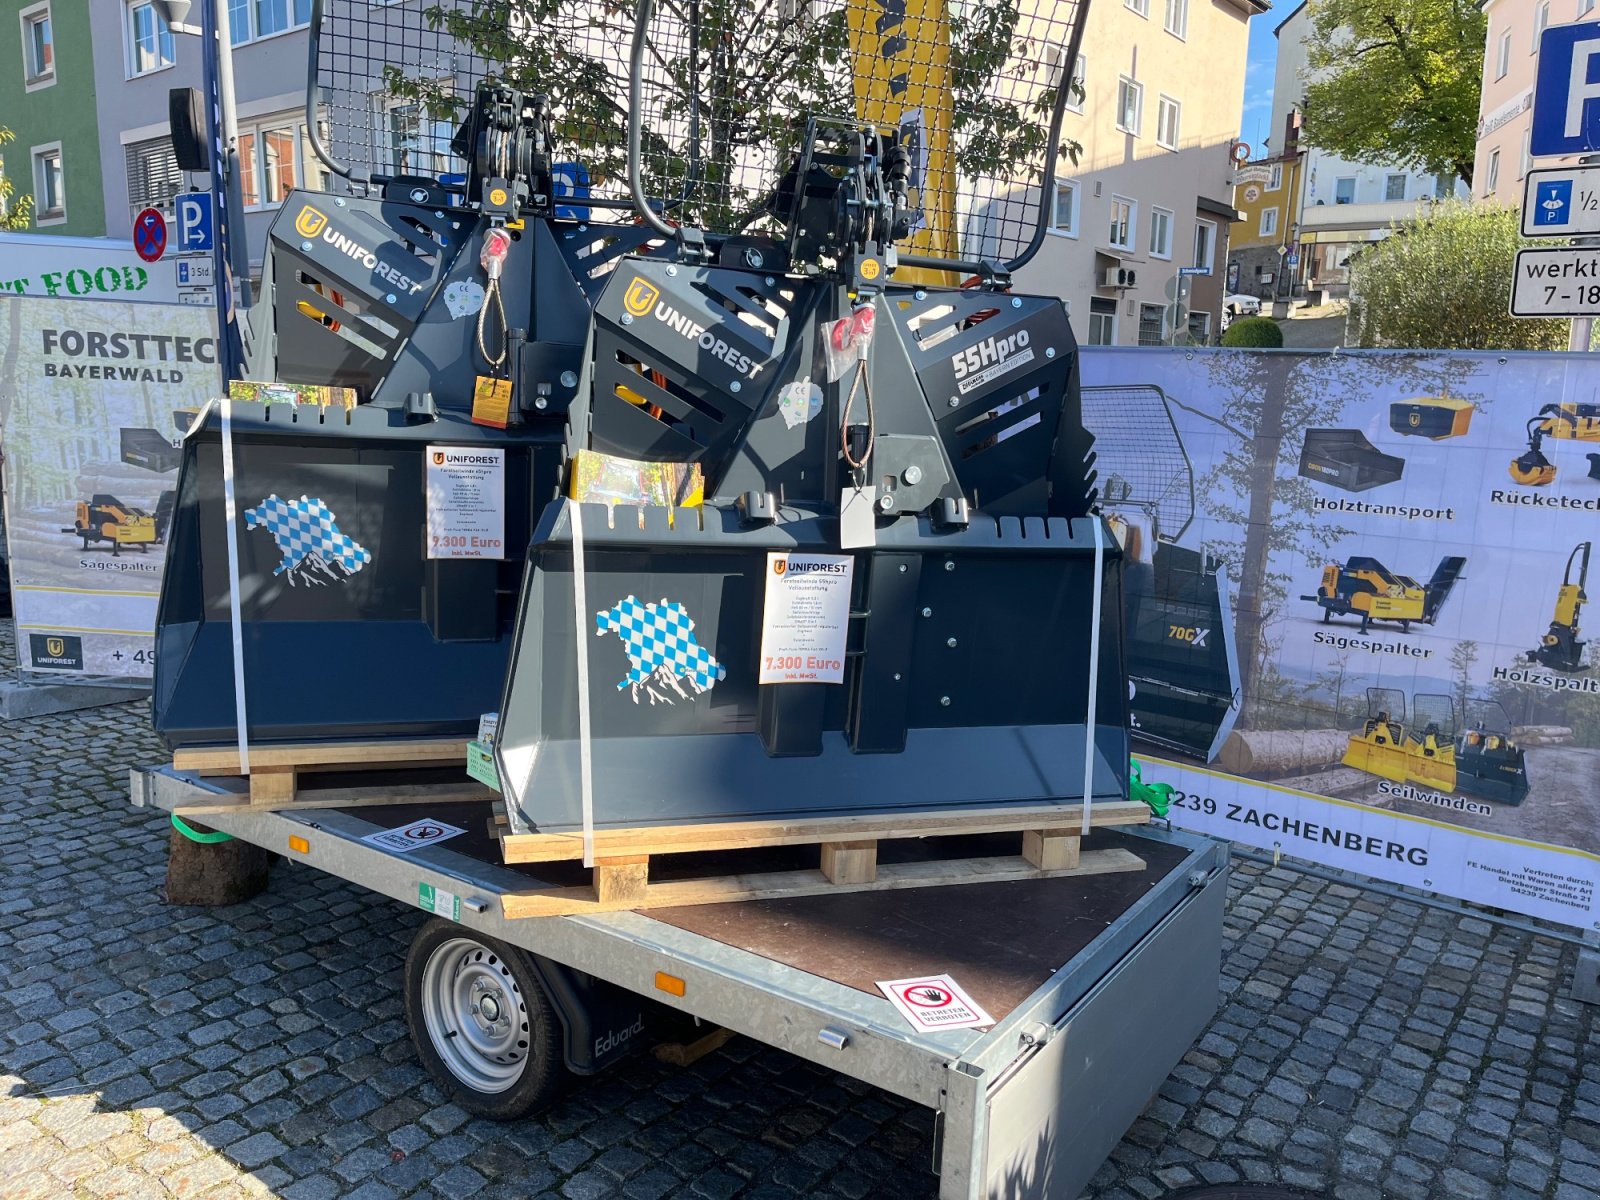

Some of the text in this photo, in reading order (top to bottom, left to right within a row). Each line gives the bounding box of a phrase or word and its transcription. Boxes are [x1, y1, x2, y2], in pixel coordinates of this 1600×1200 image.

[182, 201, 202, 244] P
[323, 227, 422, 296] UNIFOREST
[1526, 258, 1600, 279] werkt
[41, 267, 148, 296] FOOD
[42, 329, 221, 364] FORSTTEC
[654, 301, 764, 379] UNIFOREST
[952, 329, 1030, 380] 55Hpro
[45, 363, 183, 384] BAYERWALD
[446, 455, 499, 464] UNIFOREST
[1313, 497, 1454, 520] Holztransport
[470, 536, 501, 548] Euro
[788, 562, 847, 573] UNIFOREST
[1168, 625, 1210, 647] 70GX
[1313, 631, 1432, 659] Sägespalter
[37, 657, 76, 665] UNIFOREST
[766, 655, 841, 670] 7.300 Euro
[1378, 781, 1492, 816] Seilwinden
[1169, 790, 1429, 867] 239 ZACHENBERG
[1480, 864, 1509, 876] Handel
[1511, 872, 1525, 880] mit
[1528, 876, 1555, 887] Waren
[1557, 882, 1577, 892] aller
[1579, 887, 1593, 895] Art
[1523, 867, 1594, 887] Vertreten durch:
[1539, 894, 1590, 911] Zachenberg
[1549, 888, 1578, 900] Straße
[920, 1007, 965, 1016] BETRETEN
[924, 1012, 971, 1022] VERBOTEN
[595, 1012, 645, 1058] Eduard
